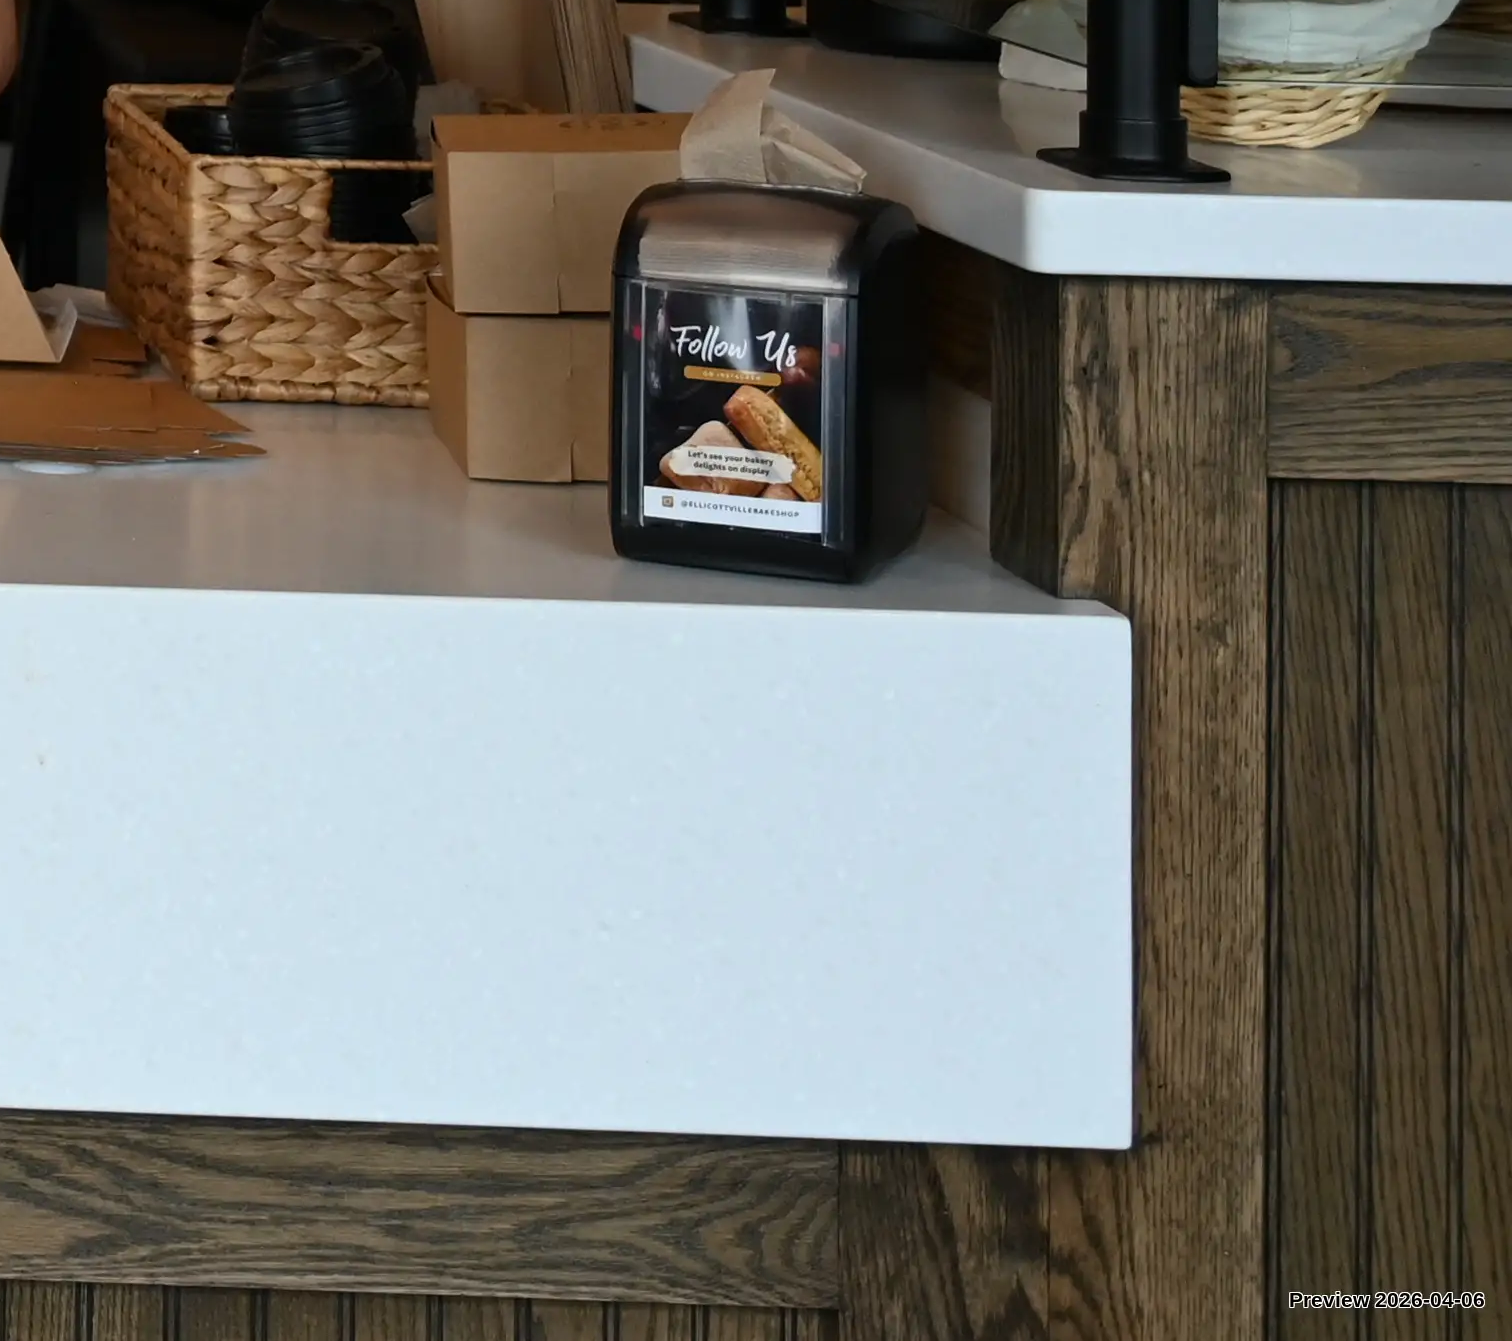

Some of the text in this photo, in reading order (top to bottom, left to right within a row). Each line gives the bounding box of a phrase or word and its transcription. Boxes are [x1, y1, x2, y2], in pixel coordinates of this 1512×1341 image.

[670, 325, 797, 372] Follow Us
[687, 450, 707, 459] Let's
[745, 455, 774, 466] bakery
[740, 465, 770, 476] display
